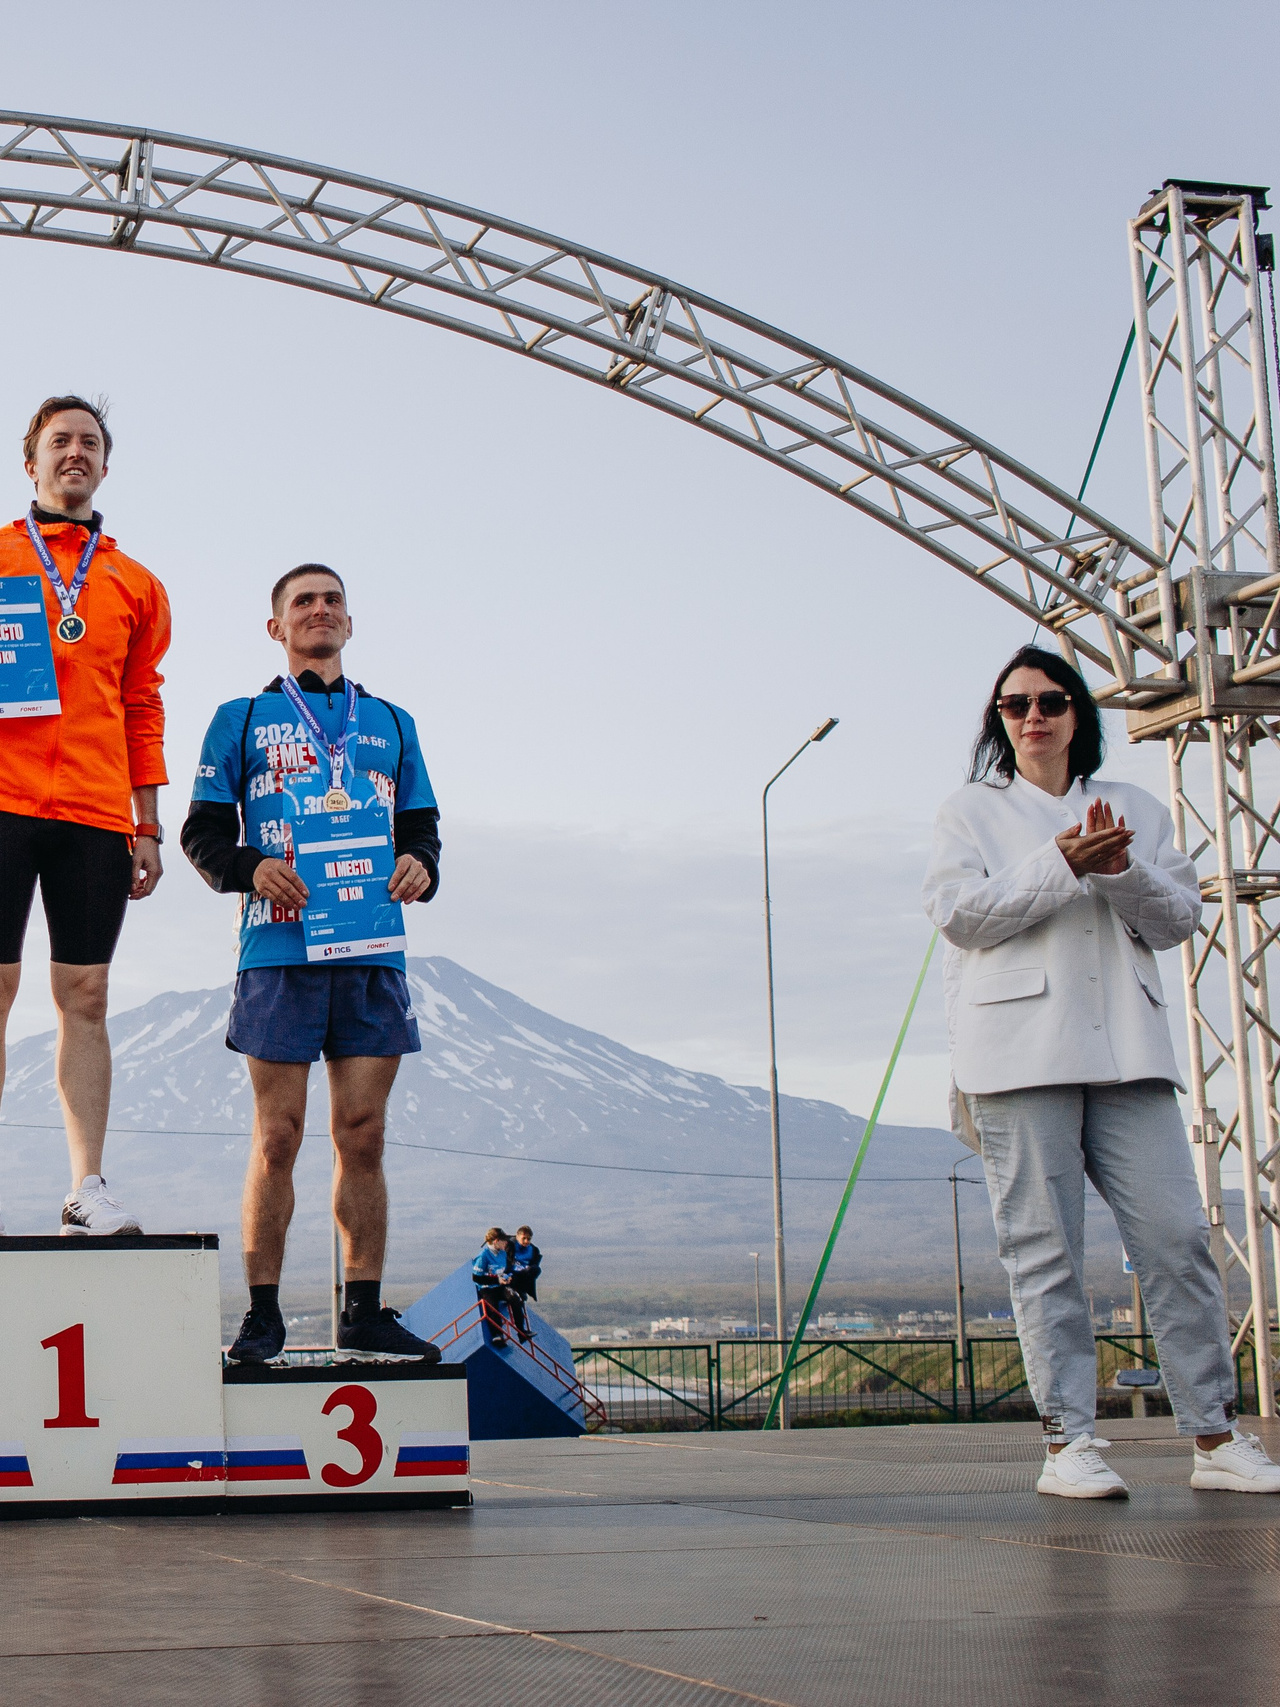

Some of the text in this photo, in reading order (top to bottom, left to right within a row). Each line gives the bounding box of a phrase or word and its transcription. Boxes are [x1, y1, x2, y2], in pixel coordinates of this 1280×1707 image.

[2, 650, 17, 664] КМ
[254, 723, 307, 750] 2024
[337, 858, 373, 877] МЕСТО
[337, 886, 364, 902] 10 КМ
[334, 946, 351, 954] ПСБ
[41, 1323, 99, 1428] 1
[321, 1385, 382, 1487] 3
